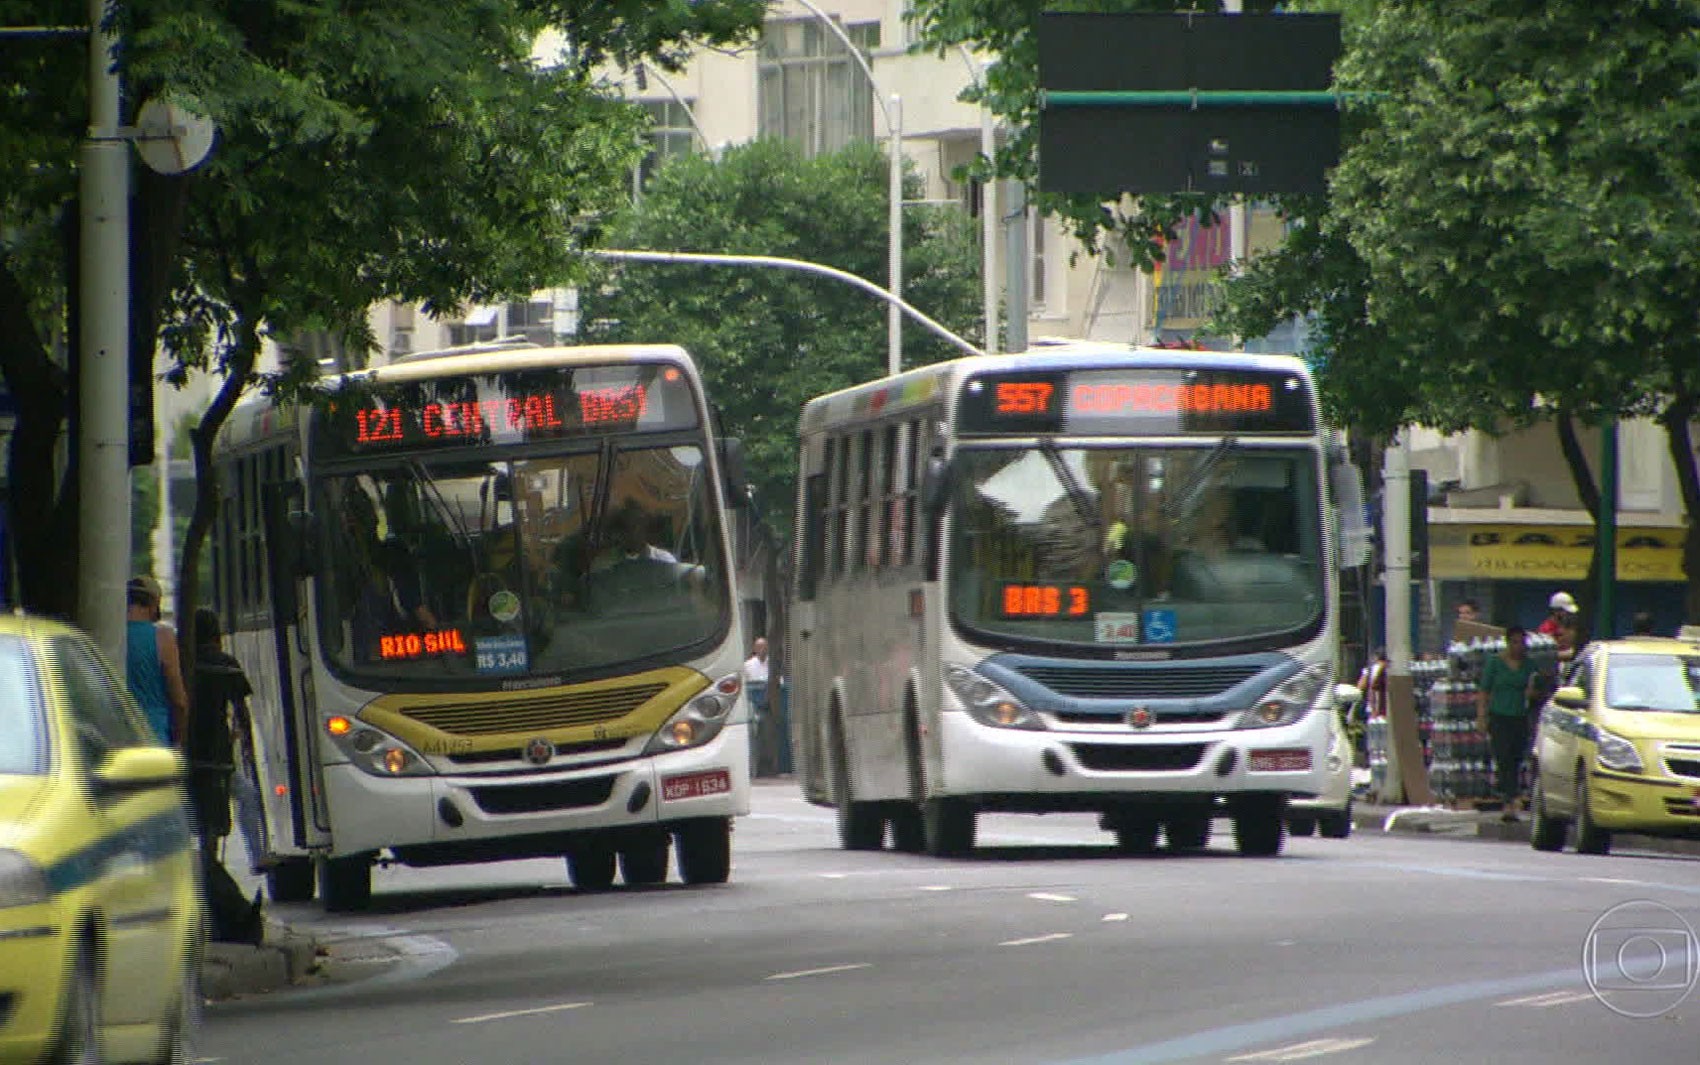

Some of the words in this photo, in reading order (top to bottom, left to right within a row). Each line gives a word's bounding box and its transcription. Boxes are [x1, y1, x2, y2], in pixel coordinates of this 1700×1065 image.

[996, 382, 1053, 412] 557
[1075, 384, 1272, 412] COPACABANA
[356, 407, 403, 442] 121
[423, 392, 562, 438] CENTRAL
[1004, 585, 1061, 616] BRS
[1068, 586, 1089, 617] 3
[379, 634, 420, 660] RIO
[424, 628, 465, 655] SUL
[499, 651, 526, 668] 3,40
